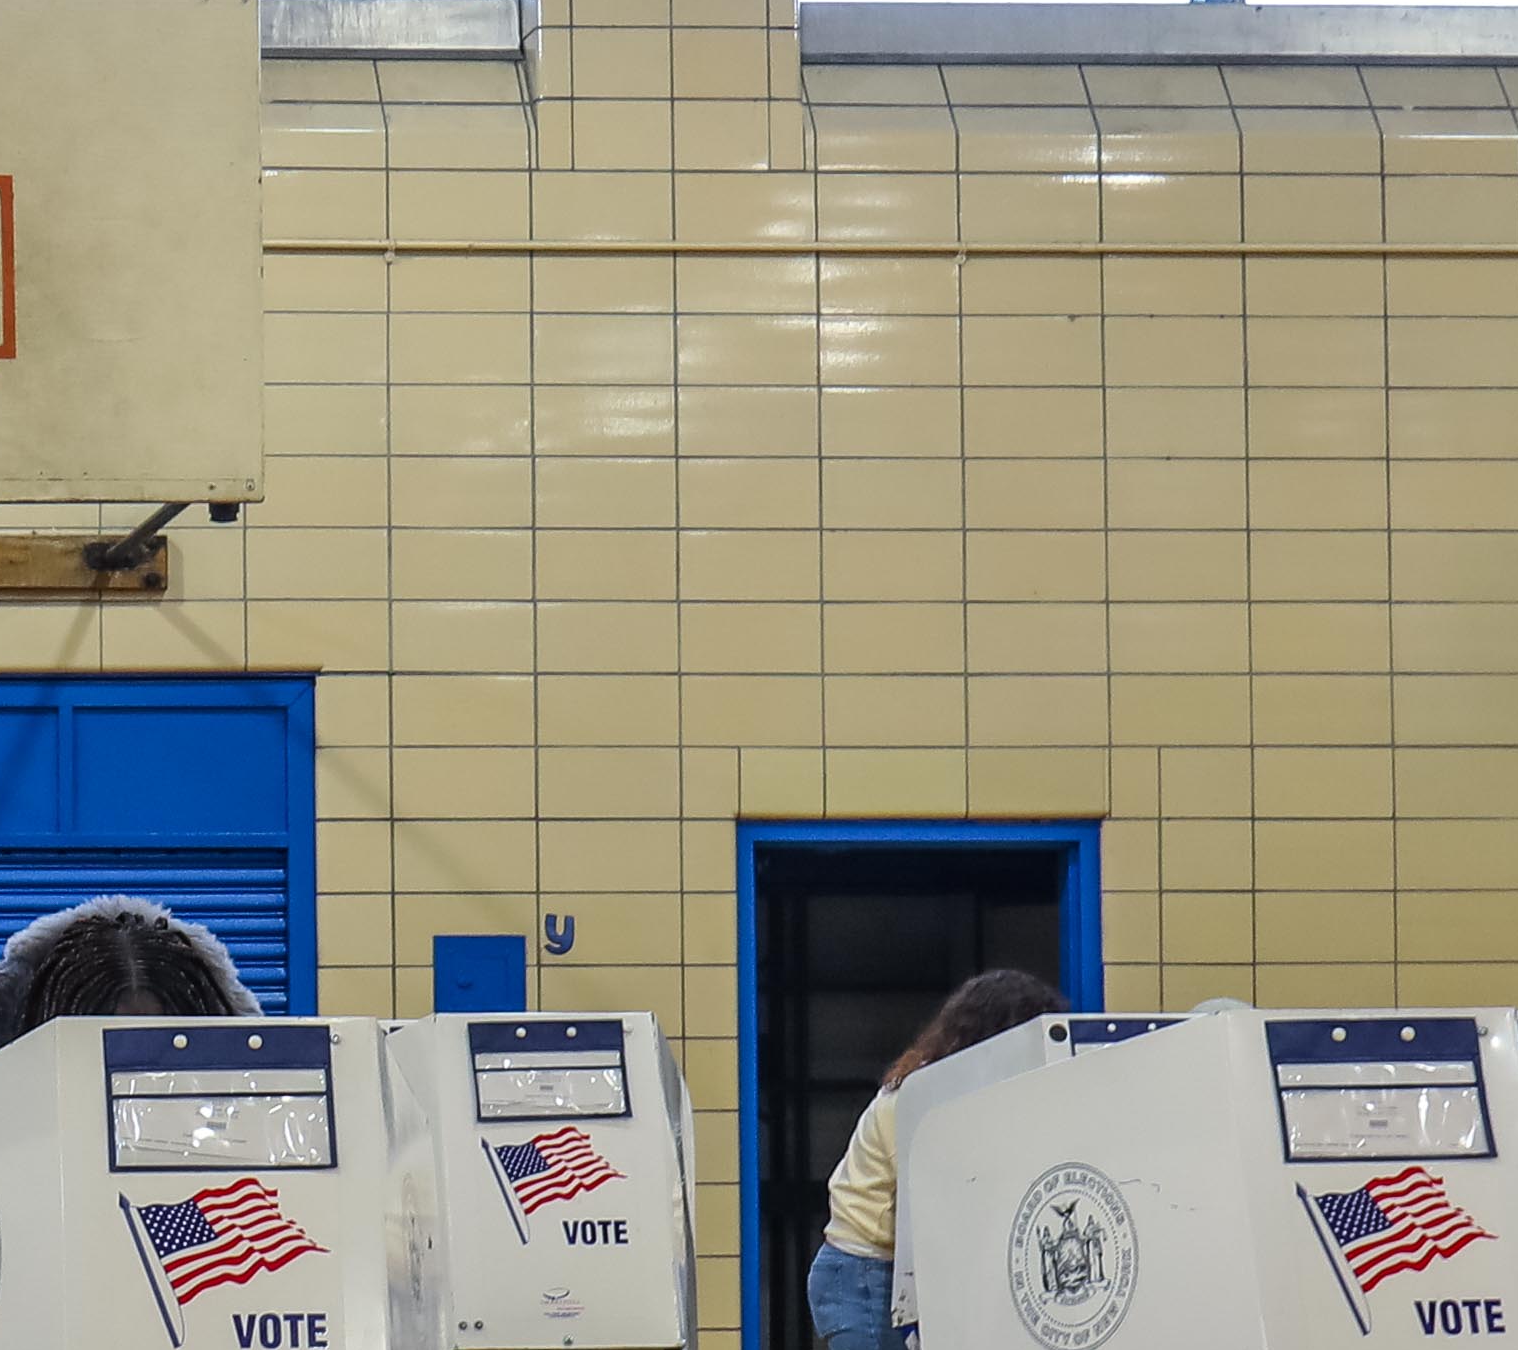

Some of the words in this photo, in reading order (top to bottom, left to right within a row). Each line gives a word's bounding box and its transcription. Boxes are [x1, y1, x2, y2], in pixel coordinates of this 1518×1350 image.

[1043, 1173, 1060, 1193] OF
[1063, 1171, 1125, 1226] ELECTIONS
[563, 1220, 629, 1245] VOTE
[232, 1313, 328, 1349] VOTE
[1041, 1324, 1071, 1346] CITY
[1073, 1329, 1090, 1346] OF
[1092, 1301, 1118, 1337] NEW
[1414, 1299, 1506, 1335] VOTE
